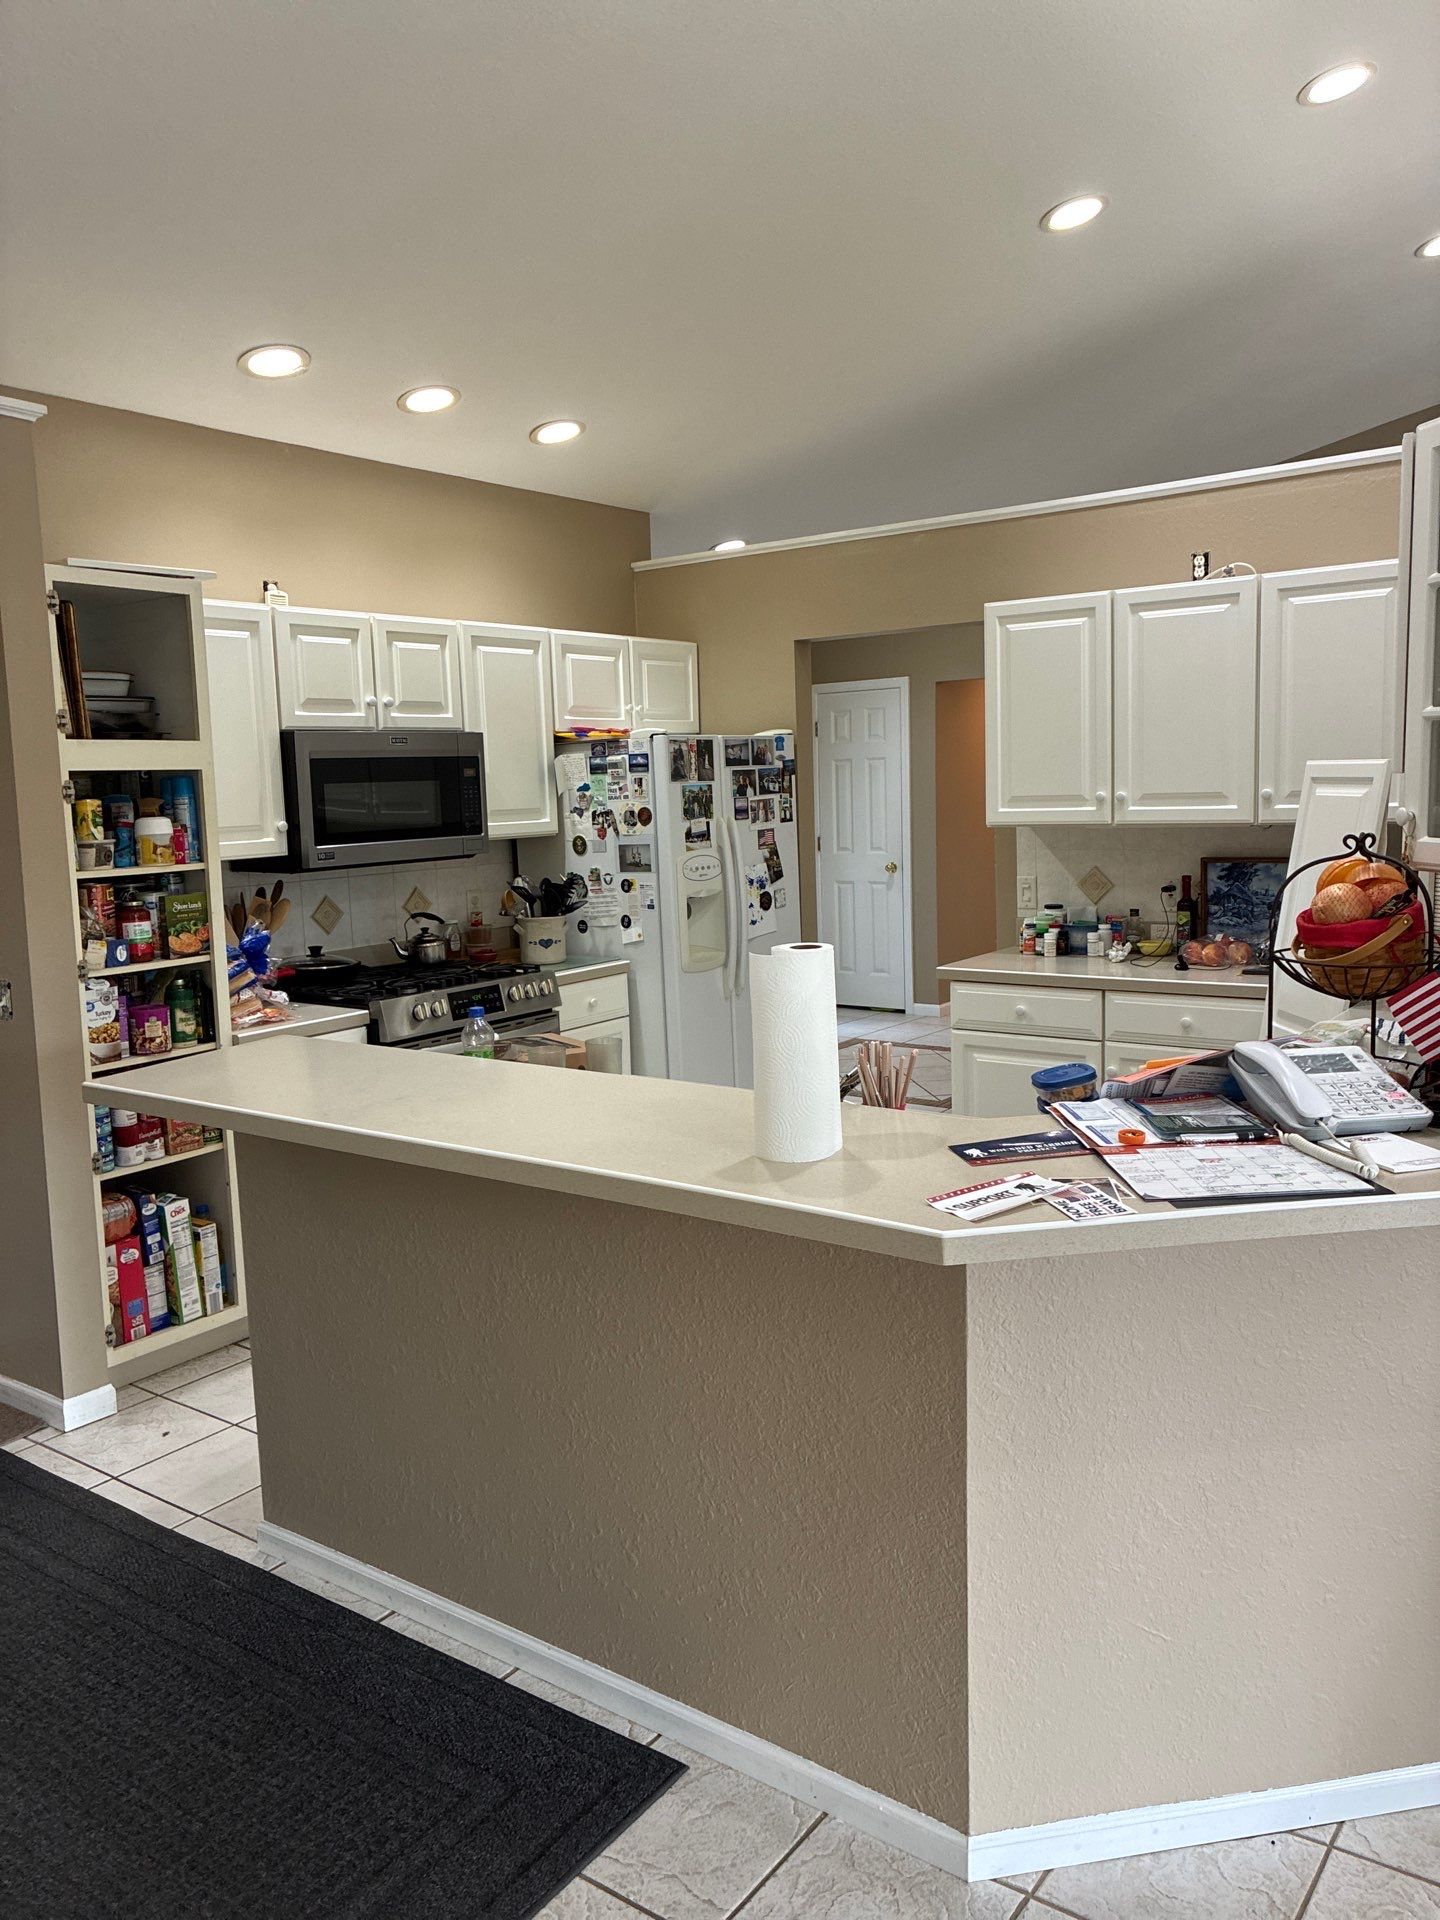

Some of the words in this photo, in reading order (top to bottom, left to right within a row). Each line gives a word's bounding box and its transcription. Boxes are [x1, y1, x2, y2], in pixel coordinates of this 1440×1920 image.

[1035, 1140, 1079, 1148] WARRIOR
[952, 1189, 1015, 1210] SUPPORT
[1091, 1194, 1128, 1214] BRAVE
[170, 1205, 186, 1218] Chex
[1053, 1200, 1088, 1218] HOME
[1078, 1202, 1107, 1216] FREE
